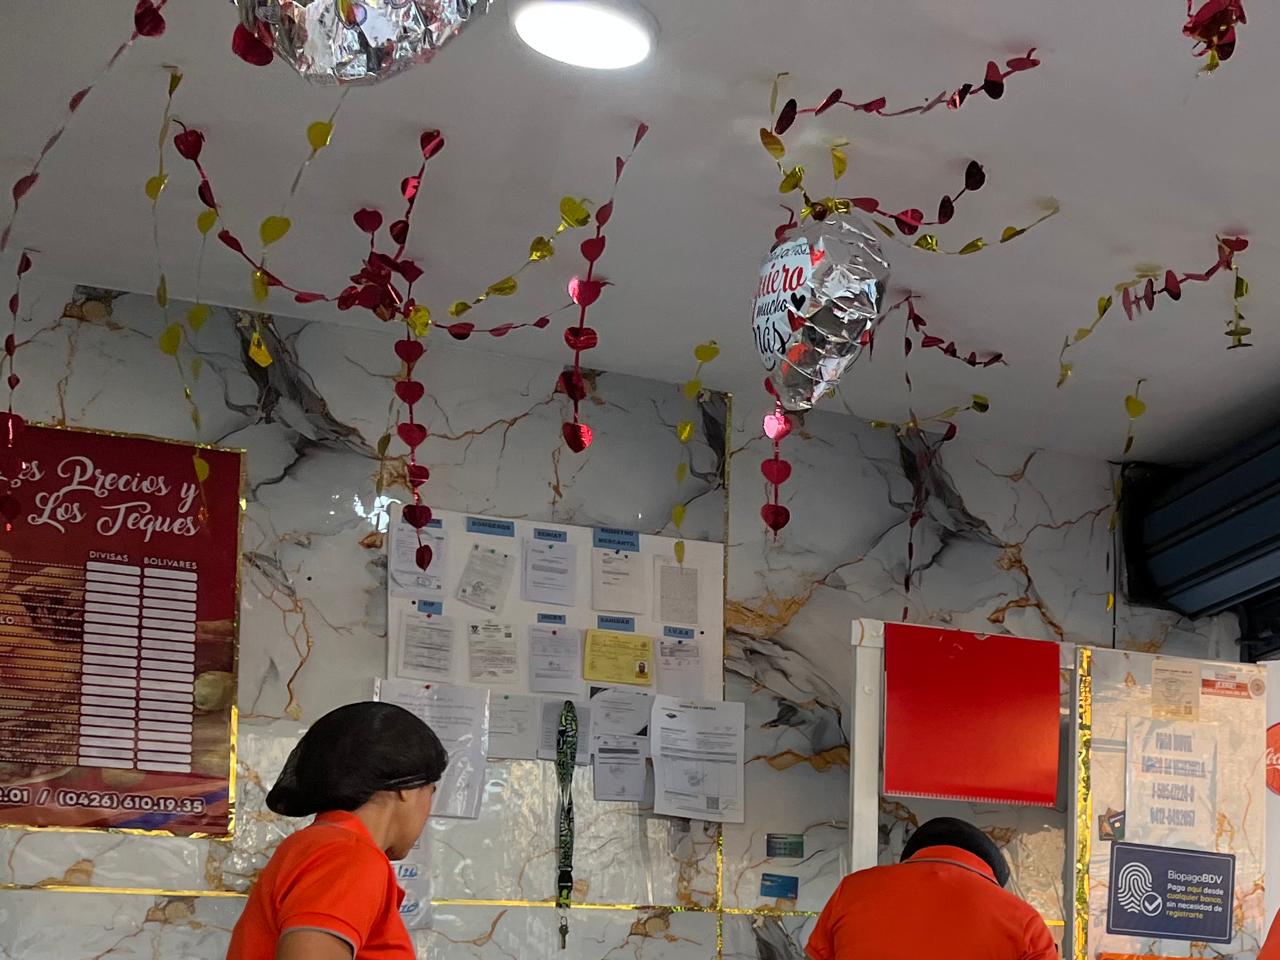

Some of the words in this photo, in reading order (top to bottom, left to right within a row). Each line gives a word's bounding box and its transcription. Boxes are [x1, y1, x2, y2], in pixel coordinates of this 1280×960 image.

[57, 456, 172, 498] Precios
[178, 482, 199, 513] y
[27, 491, 87, 534] Los
[96, 501, 201, 543] Teques
[89, 551, 129, 563] DIVISAS
[143, 557, 198, 570] BOLIVARES
[58, 791, 118, 808] (0426)
[123, 796, 203, 813] 610.19.35
[1167, 870, 1223, 884] BiopagoBDV
